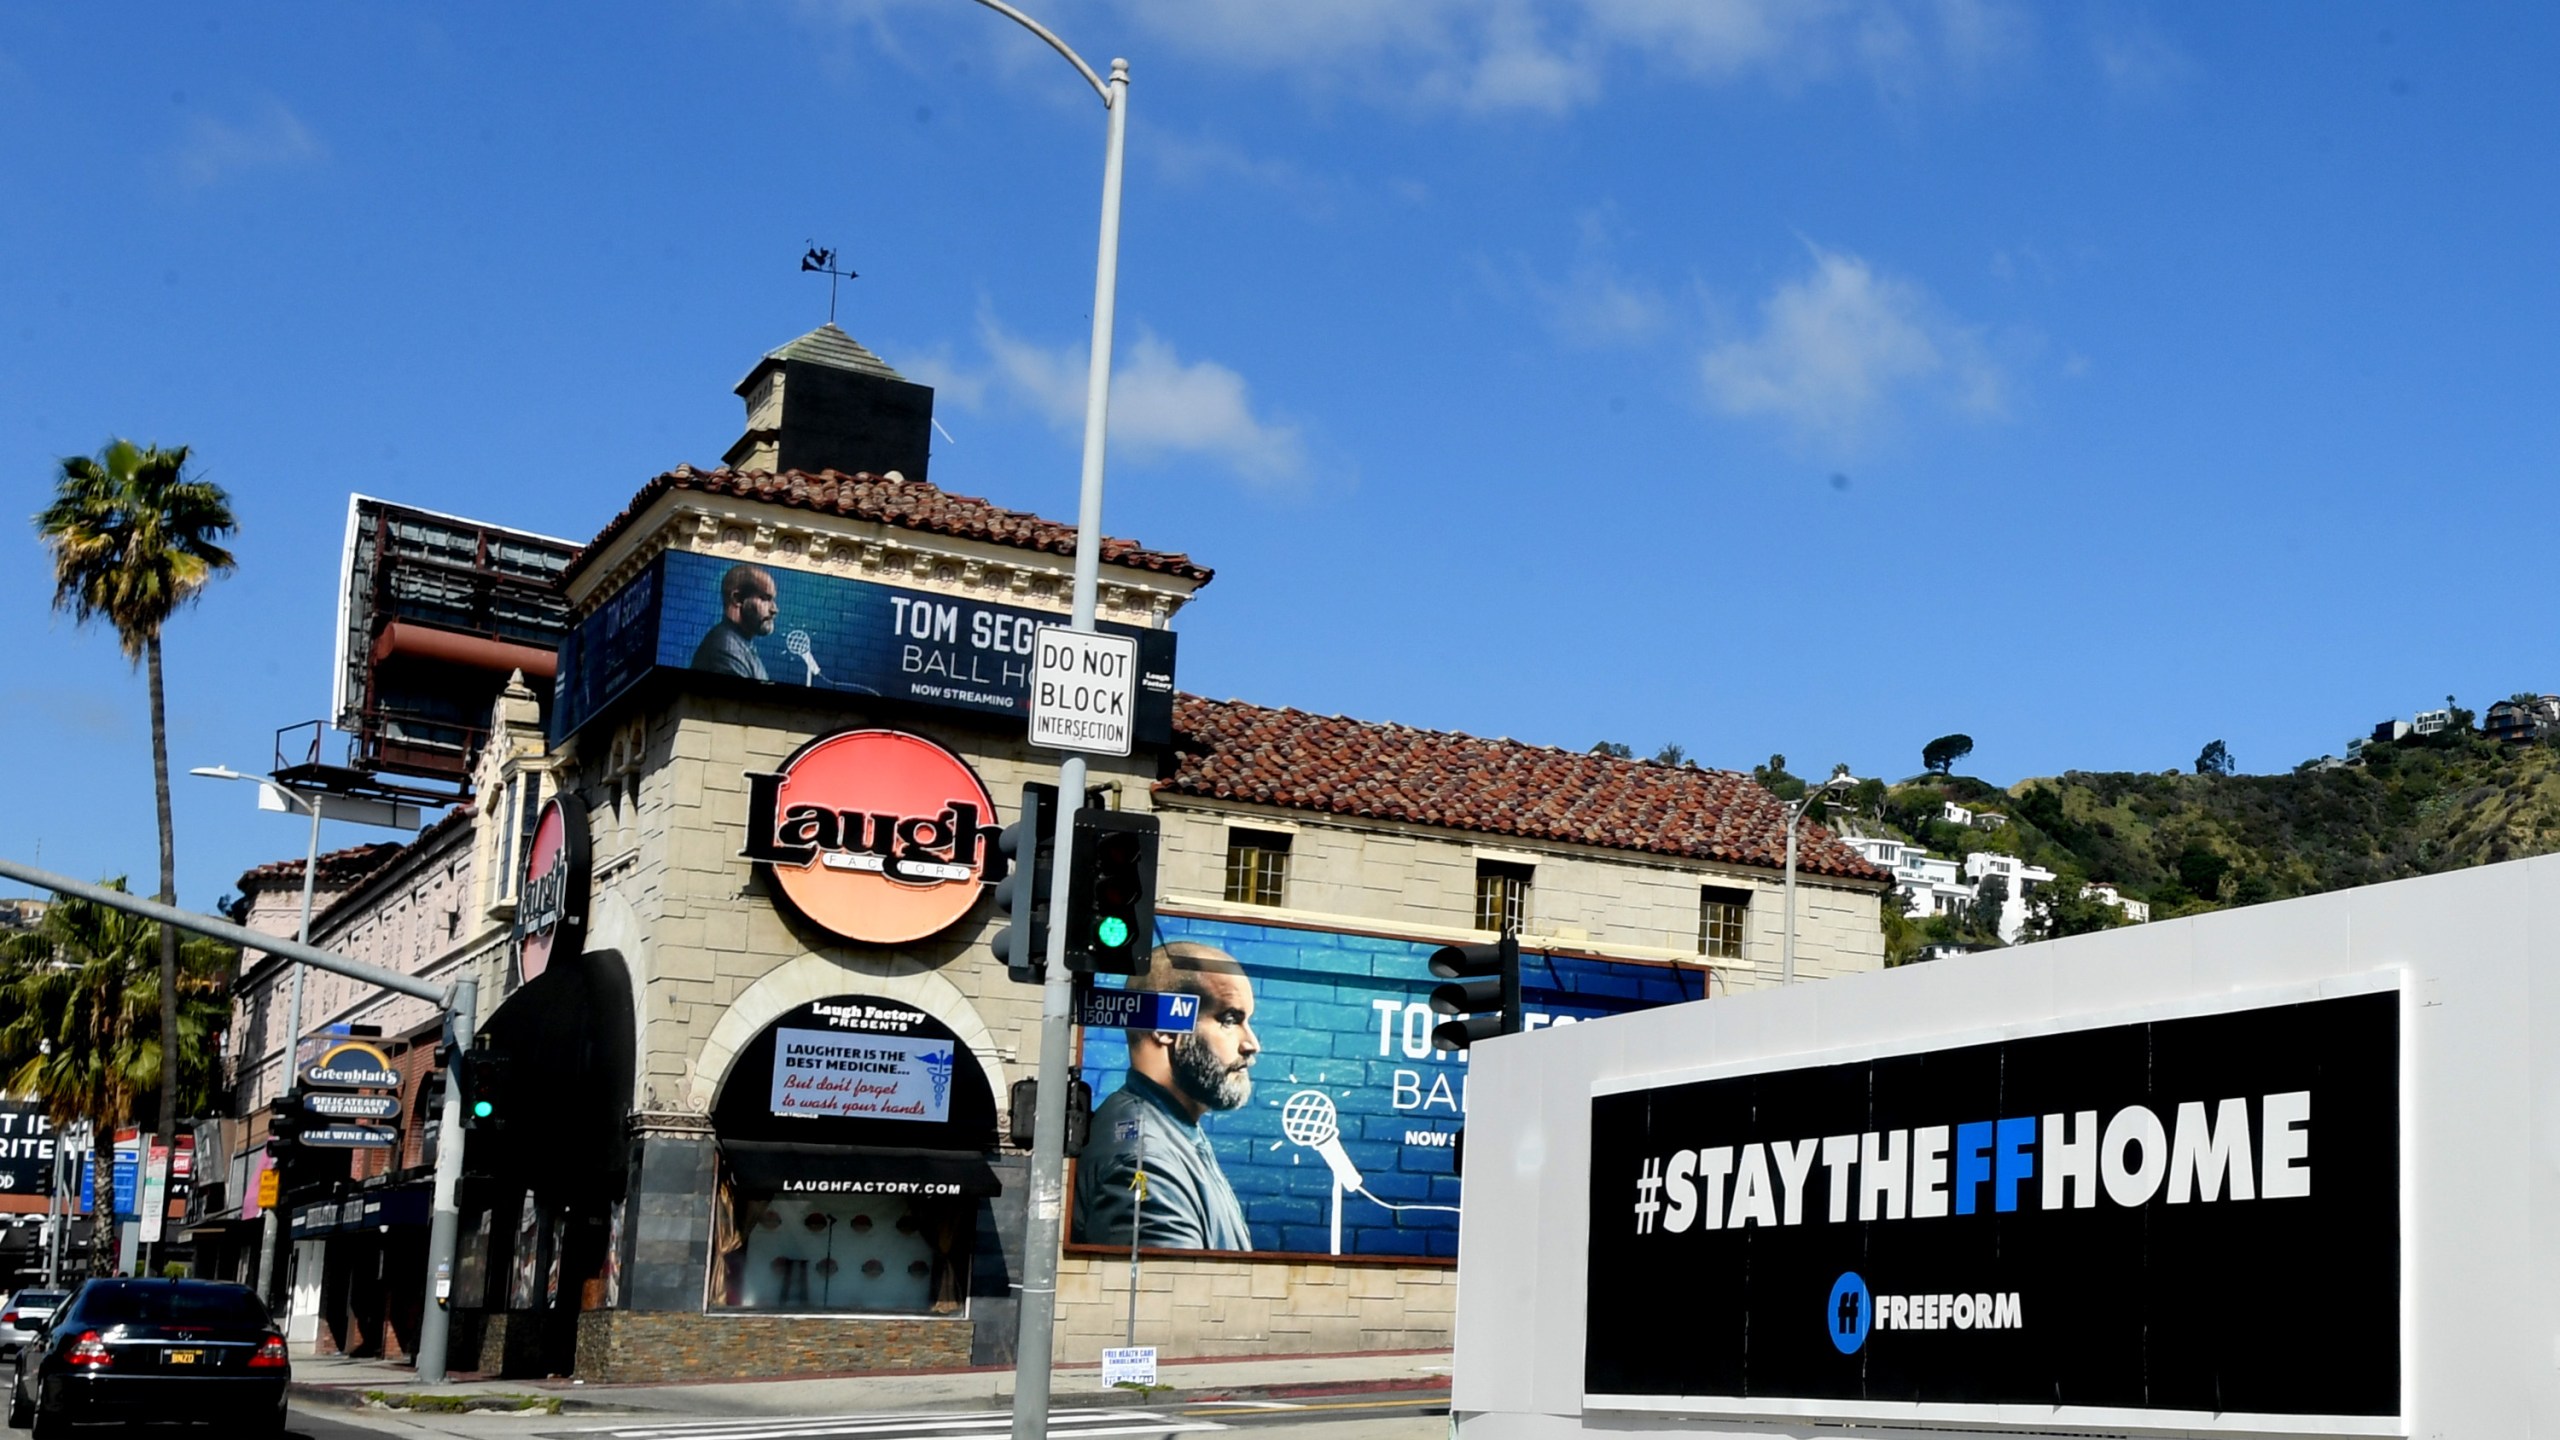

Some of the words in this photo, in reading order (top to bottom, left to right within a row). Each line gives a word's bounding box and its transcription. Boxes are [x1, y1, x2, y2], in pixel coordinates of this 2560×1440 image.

[890, 596, 958, 643] TOM
[902, 645, 990, 684] BALL
[1002, 661, 1033, 689] H
[1043, 644, 1074, 671] DO
[1083, 649, 1127, 678] NOT
[911, 683, 942, 697] NOW
[943, 688, 1014, 708] STREAMING
[1040, 682, 1124, 716] BLOCK
[1037, 715, 1124, 742] INTERSECTION
[738, 771, 1009, 886] Laugh
[812, 1002, 862, 1019] Laugh
[864, 1006, 926, 1025] Factory
[1084, 990, 1141, 1013] Laurel
[1170, 997, 1193, 1017] Av
[829, 1017, 908, 1031] PRESENTS
[1083, 1010, 1113, 1025] 1500
[1119, 1013, 1128, 1026] N
[787, 1044, 862, 1060] LAUGHTER
[864, 1049, 876, 1060] IS
[880, 1050, 906, 1062] THE
[310, 1067, 398, 1085] Greenblatt's
[786, 1057, 822, 1069] BEST
[826, 1061, 910, 1076] MEDICINE...
[784, 1073, 814, 1089] But
[853, 1078, 898, 1099] forget
[312, 1096, 391, 1108] DELICATESSEN
[316, 1104, 386, 1115] RESTAURANT
[782, 1093, 796, 1107] to
[800, 1096, 837, 1110] wash
[842, 1101, 878, 1115] your
[881, 1099, 925, 1115] hands
[304, 1130, 331, 1140] FINE
[333, 1131, 362, 1141] WINE
[364, 1132, 395, 1142] SHOP
[1405, 1131, 1448, 1147] NOW
[1636, 1091, 2311, 1235] #STAYTHEFFHOME
[783, 1180, 961, 1195] LAUGHFACTORY.COM
[1875, 1292, 2023, 1331] FREEFORM
